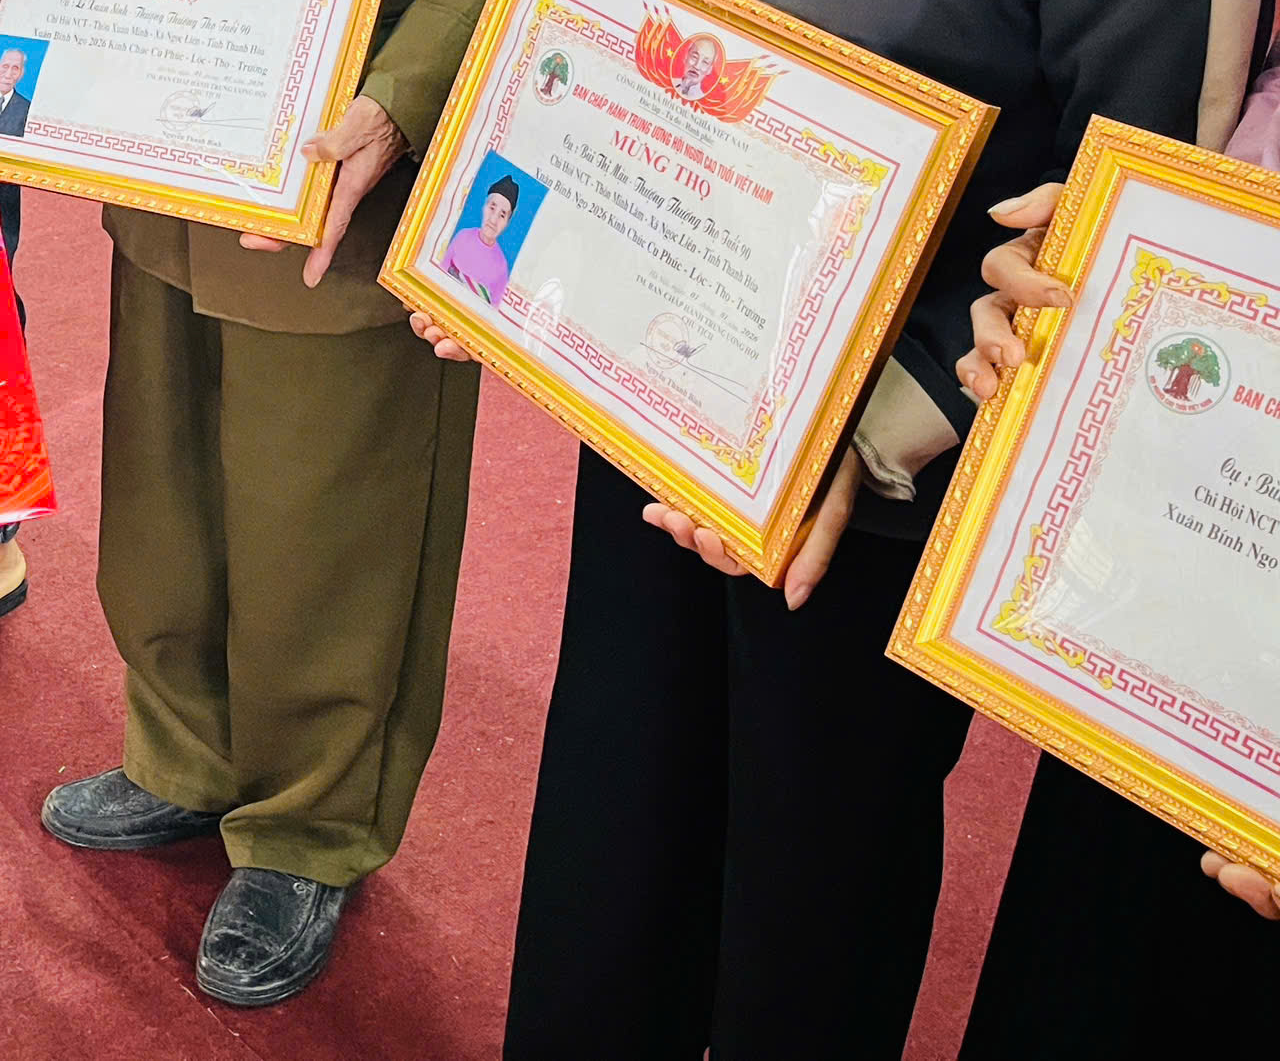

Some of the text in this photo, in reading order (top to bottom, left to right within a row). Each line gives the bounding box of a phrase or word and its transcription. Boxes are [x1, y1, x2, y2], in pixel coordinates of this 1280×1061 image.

[87, 36, 106, 48] 2026
[611, 130, 710, 201] MỪNG THỌ
[575, 167, 591, 186] NCT
[612, 191, 629, 211] Minh
[721, 258, 743, 282] Thanh
[587, 202, 607, 221] 2026
[739, 243, 751, 261] 90
[1232, 384, 1261, 413] BAN
[1220, 457, 1242, 487] Cụ
[1194, 485, 1280, 537] Chi Hội NCT
[1161, 501, 1280, 573] Xuân Bính Ngọ
